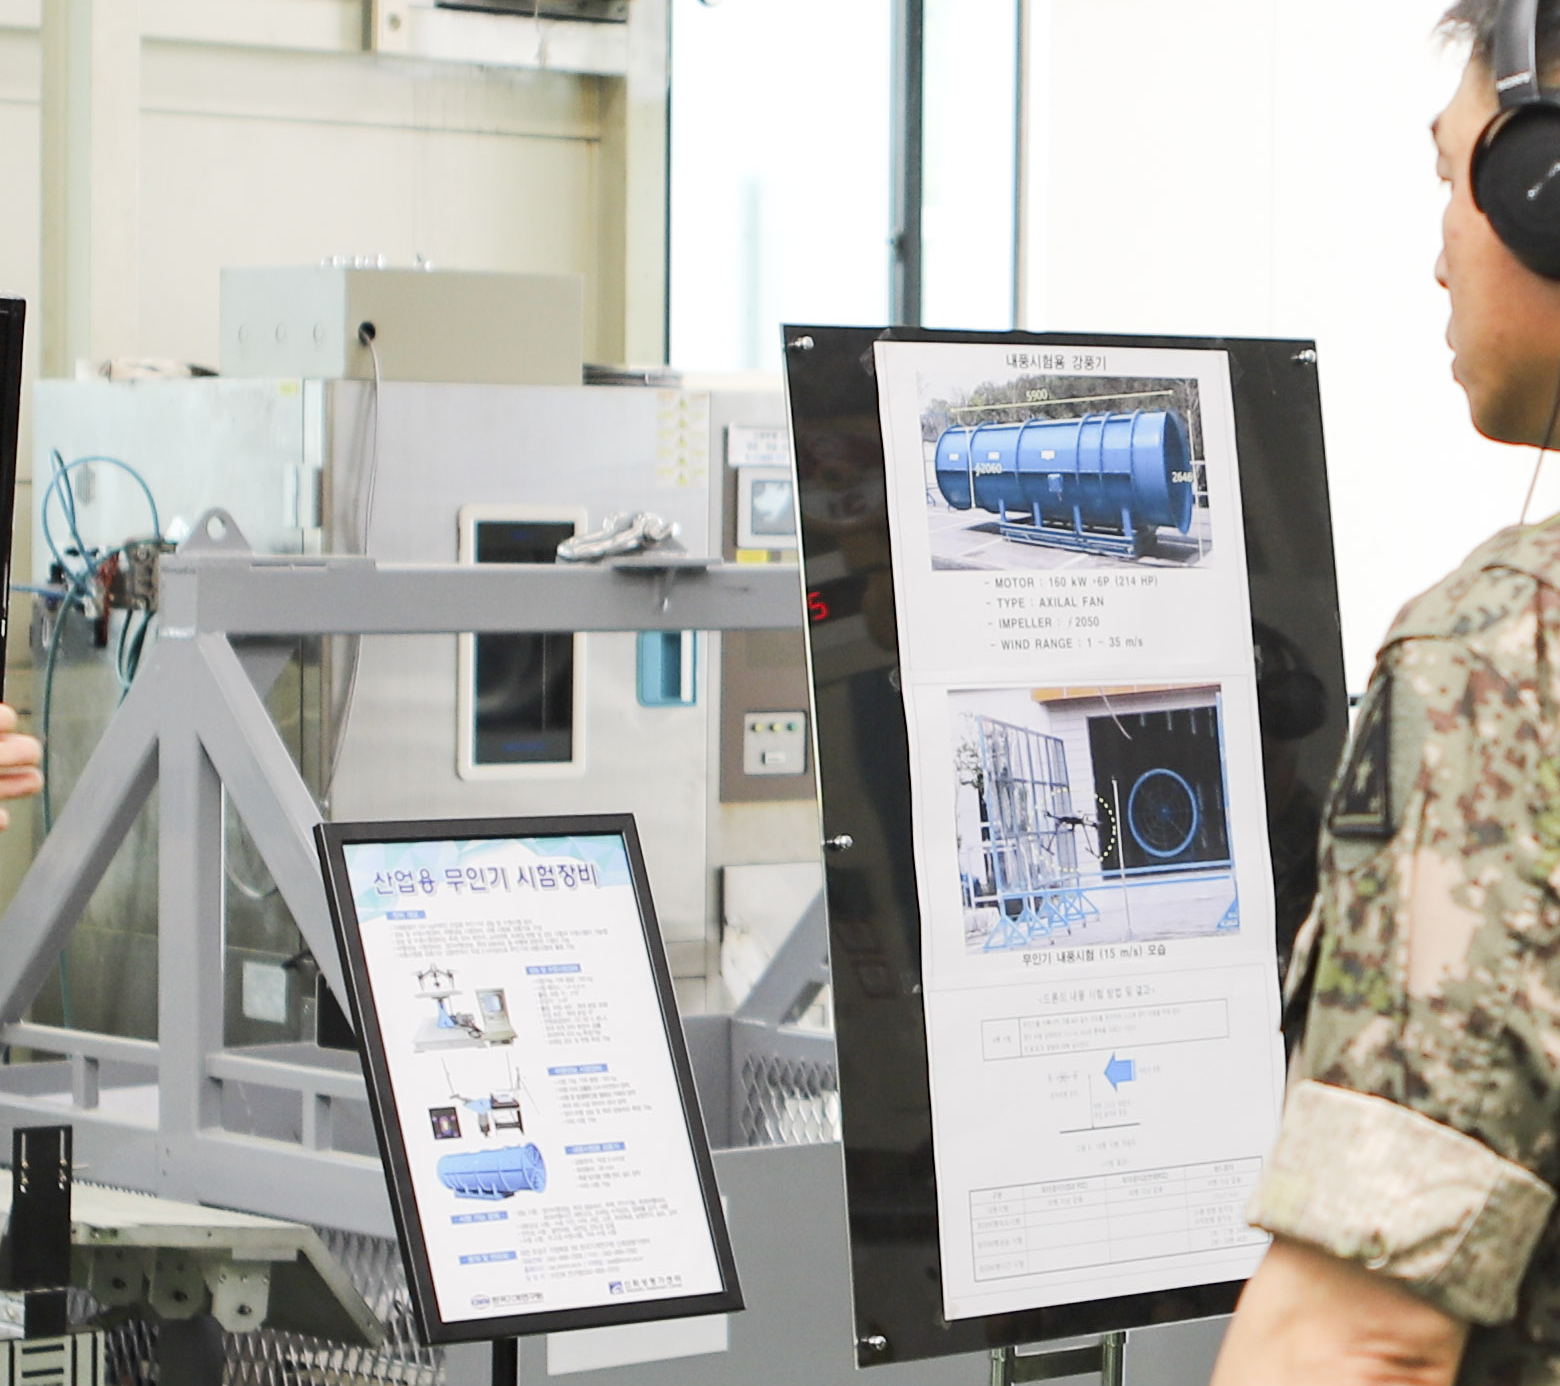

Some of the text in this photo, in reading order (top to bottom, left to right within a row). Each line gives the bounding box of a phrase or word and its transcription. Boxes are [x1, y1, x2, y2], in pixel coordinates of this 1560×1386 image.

[1006, 353, 1108, 371] 내풍시험용 강풍기
[1026, 389, 1049, 401] 5900
[995, 577, 1034, 589] MOTOR
[1048, 577, 1066, 588] 160
[1071, 576, 1088, 587] kW
[1115, 575, 1136, 587] (214
[1141, 574, 1158, 587] HP)
[997, 597, 1025, 609] TYPE
[1039, 596, 1077, 608] AXILAL
[1082, 596, 1104, 607] FAN
[999, 617, 1052, 629] IMPELLER
[1001, 639, 1030, 650] WIND
[1035, 638, 1073, 650] RANGE
[1109, 637, 1121, 648] 35
[1125, 636, 1143, 648] m/s
[373, 863, 598, 896] 산업용 무인기 시험장비
[1022, 944, 1167, 966] 무인기 내풍시험 (15 m/s) 모습
